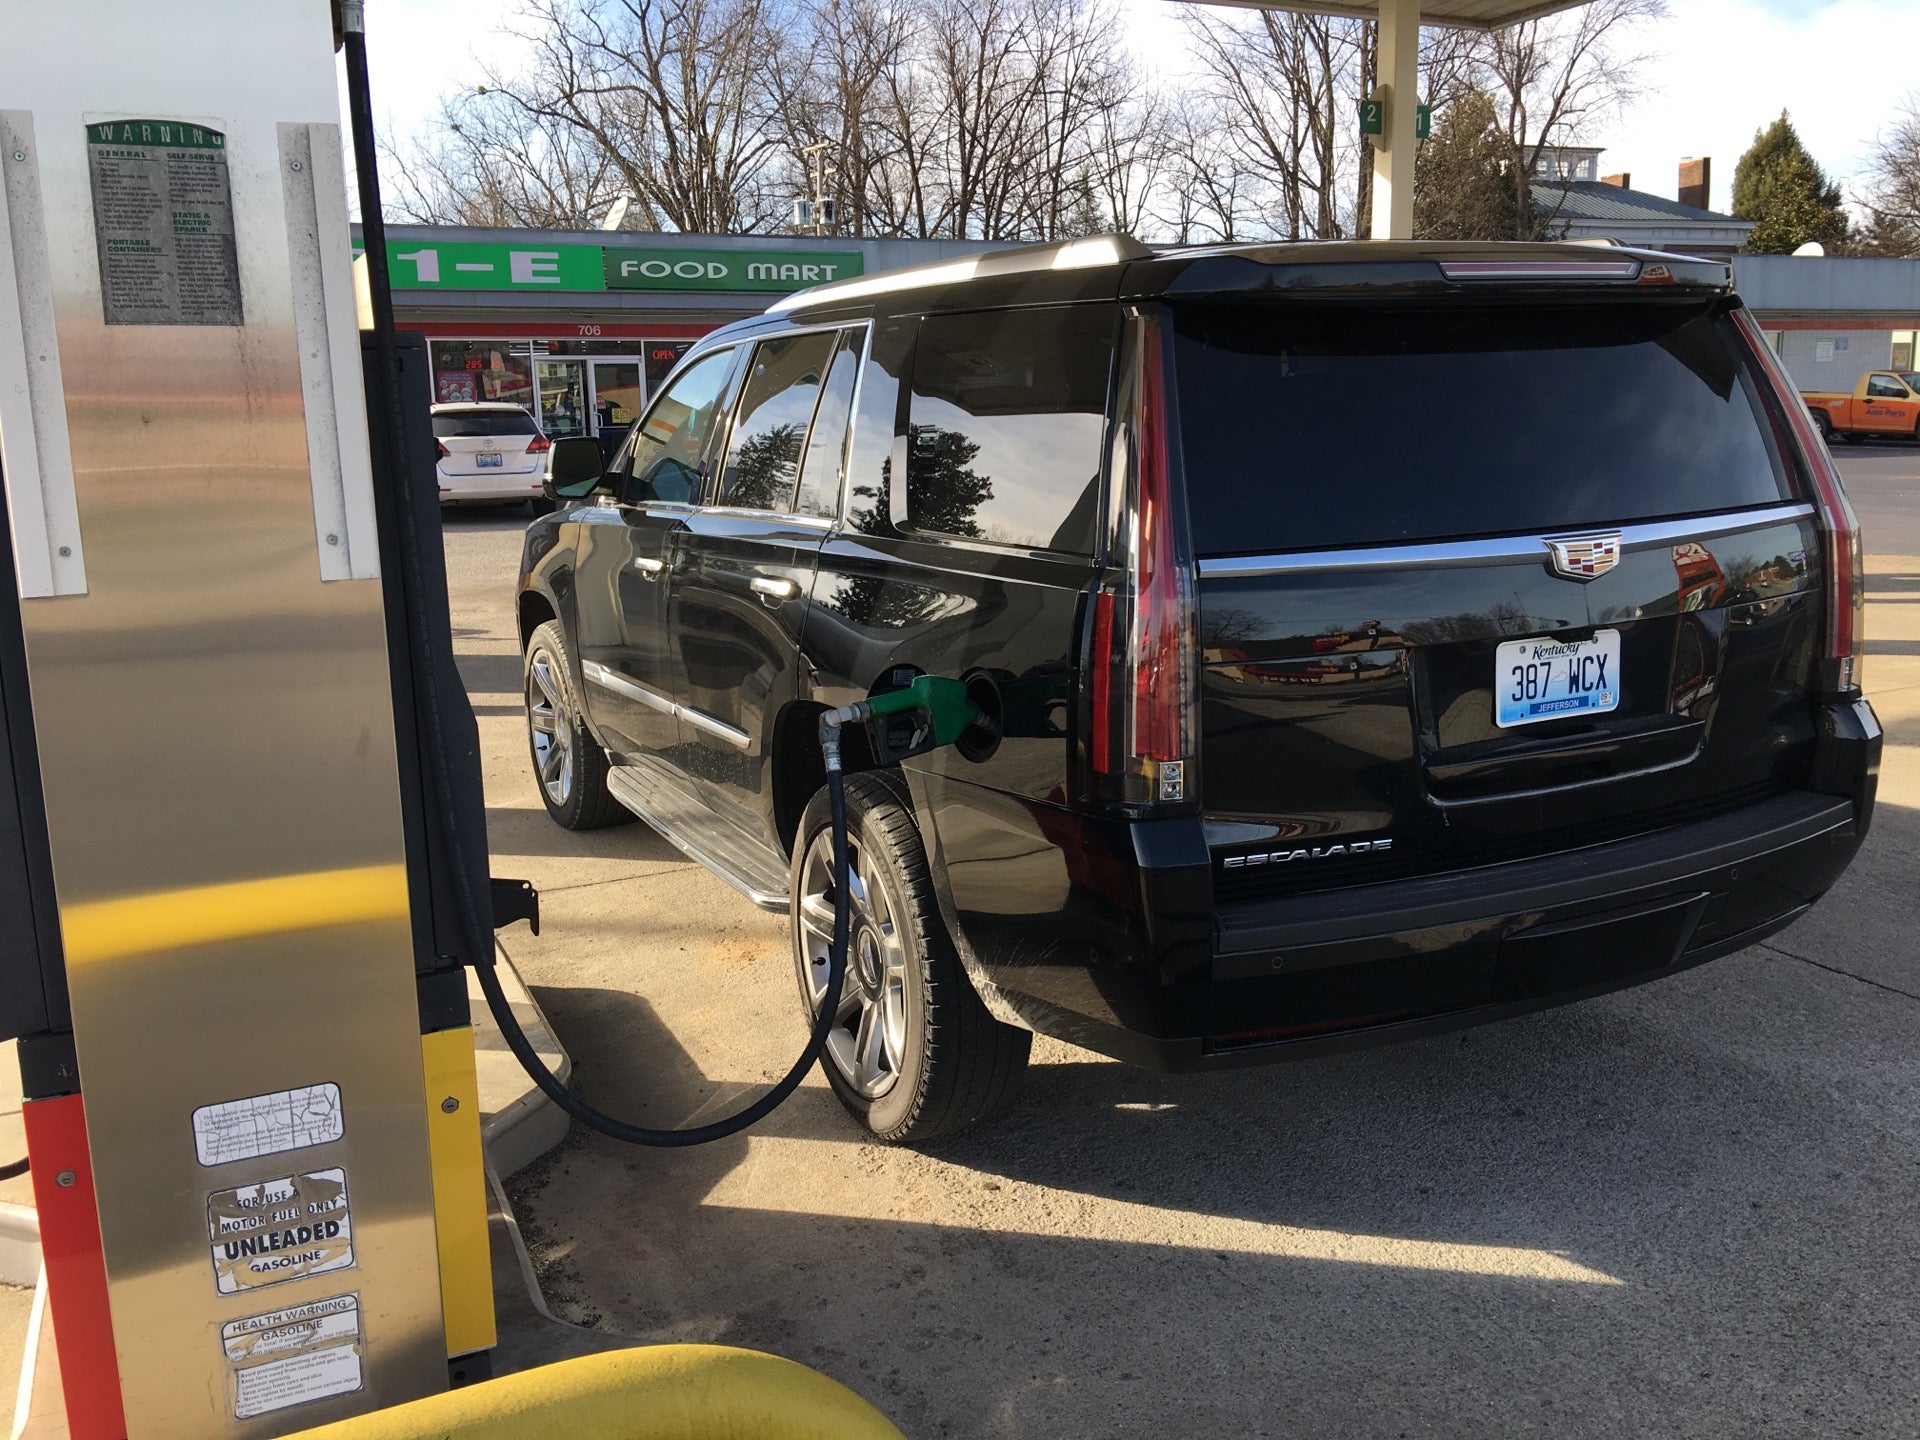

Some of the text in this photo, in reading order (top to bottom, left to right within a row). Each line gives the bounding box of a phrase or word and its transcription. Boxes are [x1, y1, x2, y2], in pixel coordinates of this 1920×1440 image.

[1367, 104, 1377, 122] 2
[98, 150, 147, 158] GENERAL
[620, 260, 838, 281] FOOD MART
[577, 325, 602, 336] 706
[652, 349, 675, 360] OPEN
[1532, 643, 1581, 660] Kentucky
[1512, 653, 1608, 702] 387 WCX
[1538, 699, 1580, 713] JEFFERSON
[1223, 838, 1393, 869] ESCALADE
[265, 1190, 287, 1203] USE
[221, 1199, 338, 1234] MOTOR FUEL ONLY
[224, 1220, 340, 1260] UNLEADED
[251, 1250, 321, 1272] GASOLINE
[232, 1299, 347, 1333] HEALTH WARNING
[261, 1319, 323, 1341] GASOLINE
